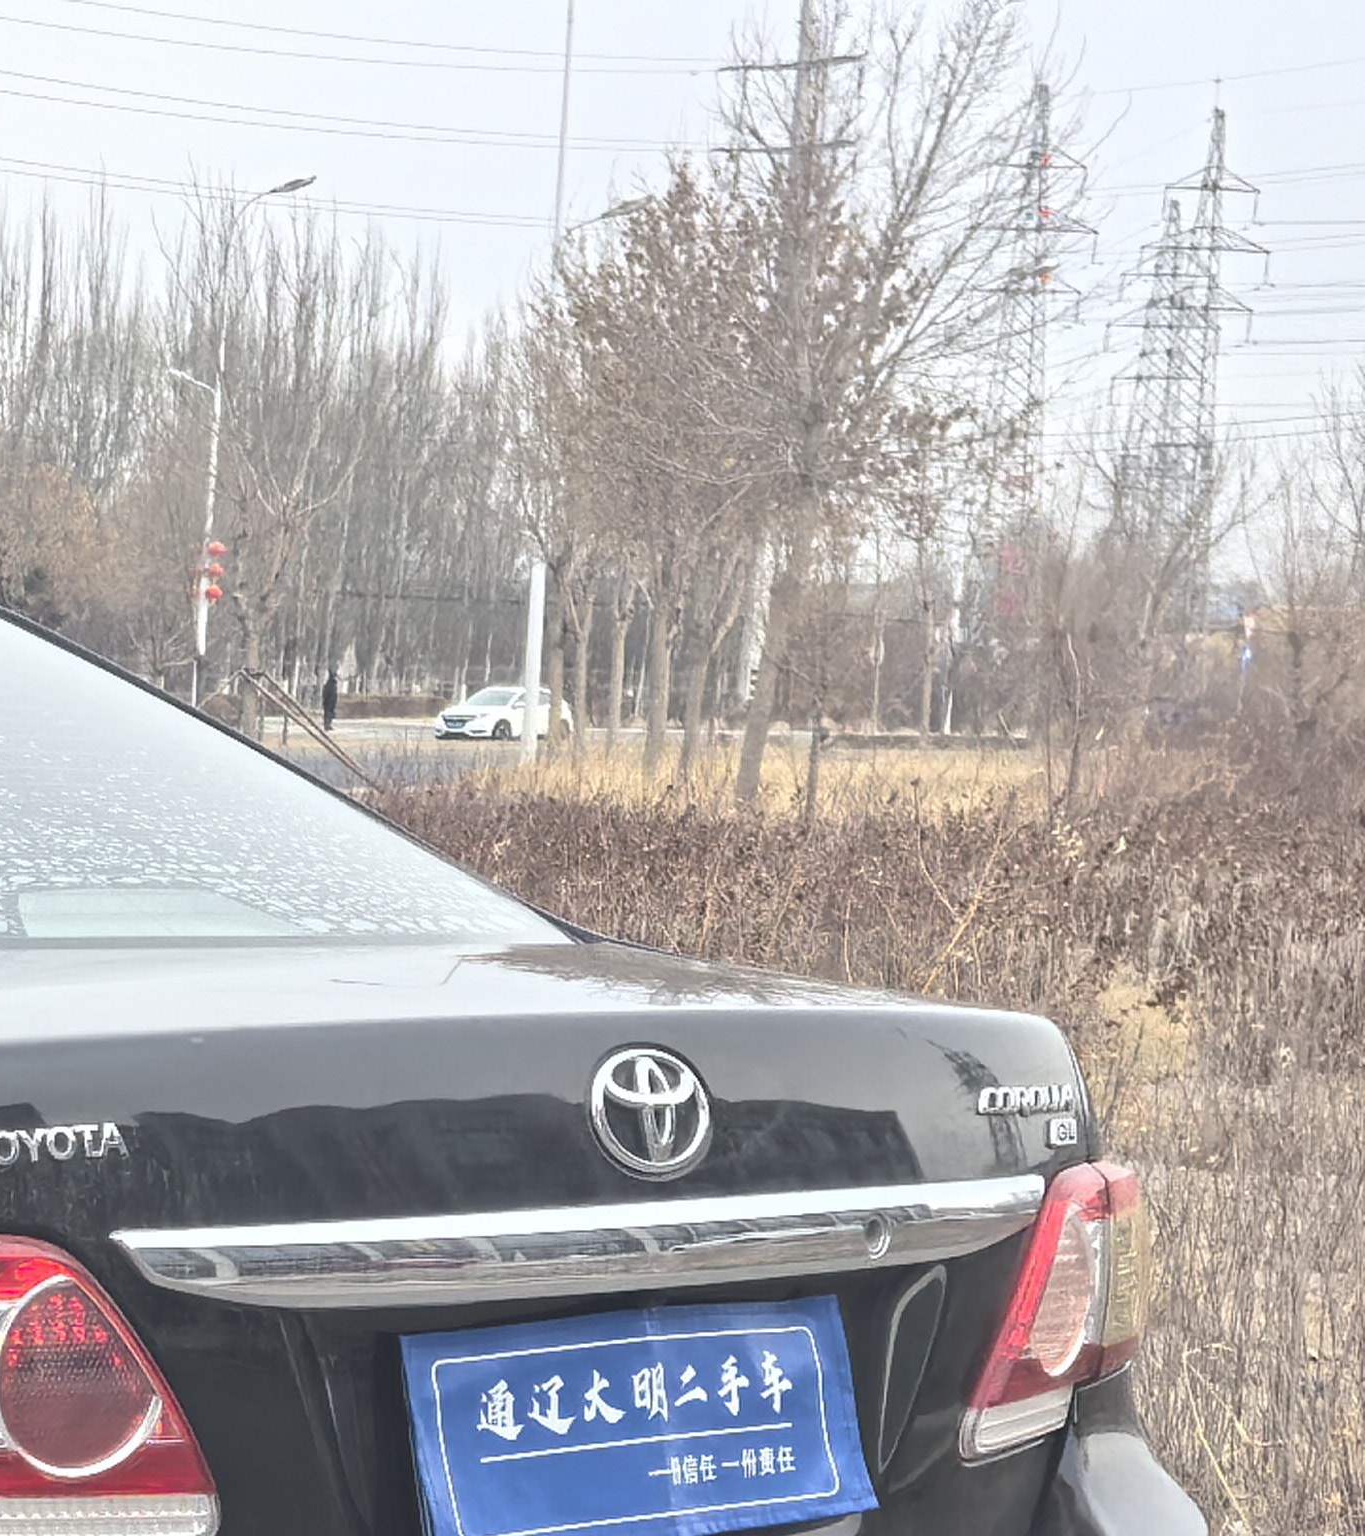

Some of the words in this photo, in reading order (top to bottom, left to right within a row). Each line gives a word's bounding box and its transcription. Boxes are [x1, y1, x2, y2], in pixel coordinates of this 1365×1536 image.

[1057, 1123, 1076, 1142] GL
[476, 1350, 794, 1441] 通辽大明二手车
